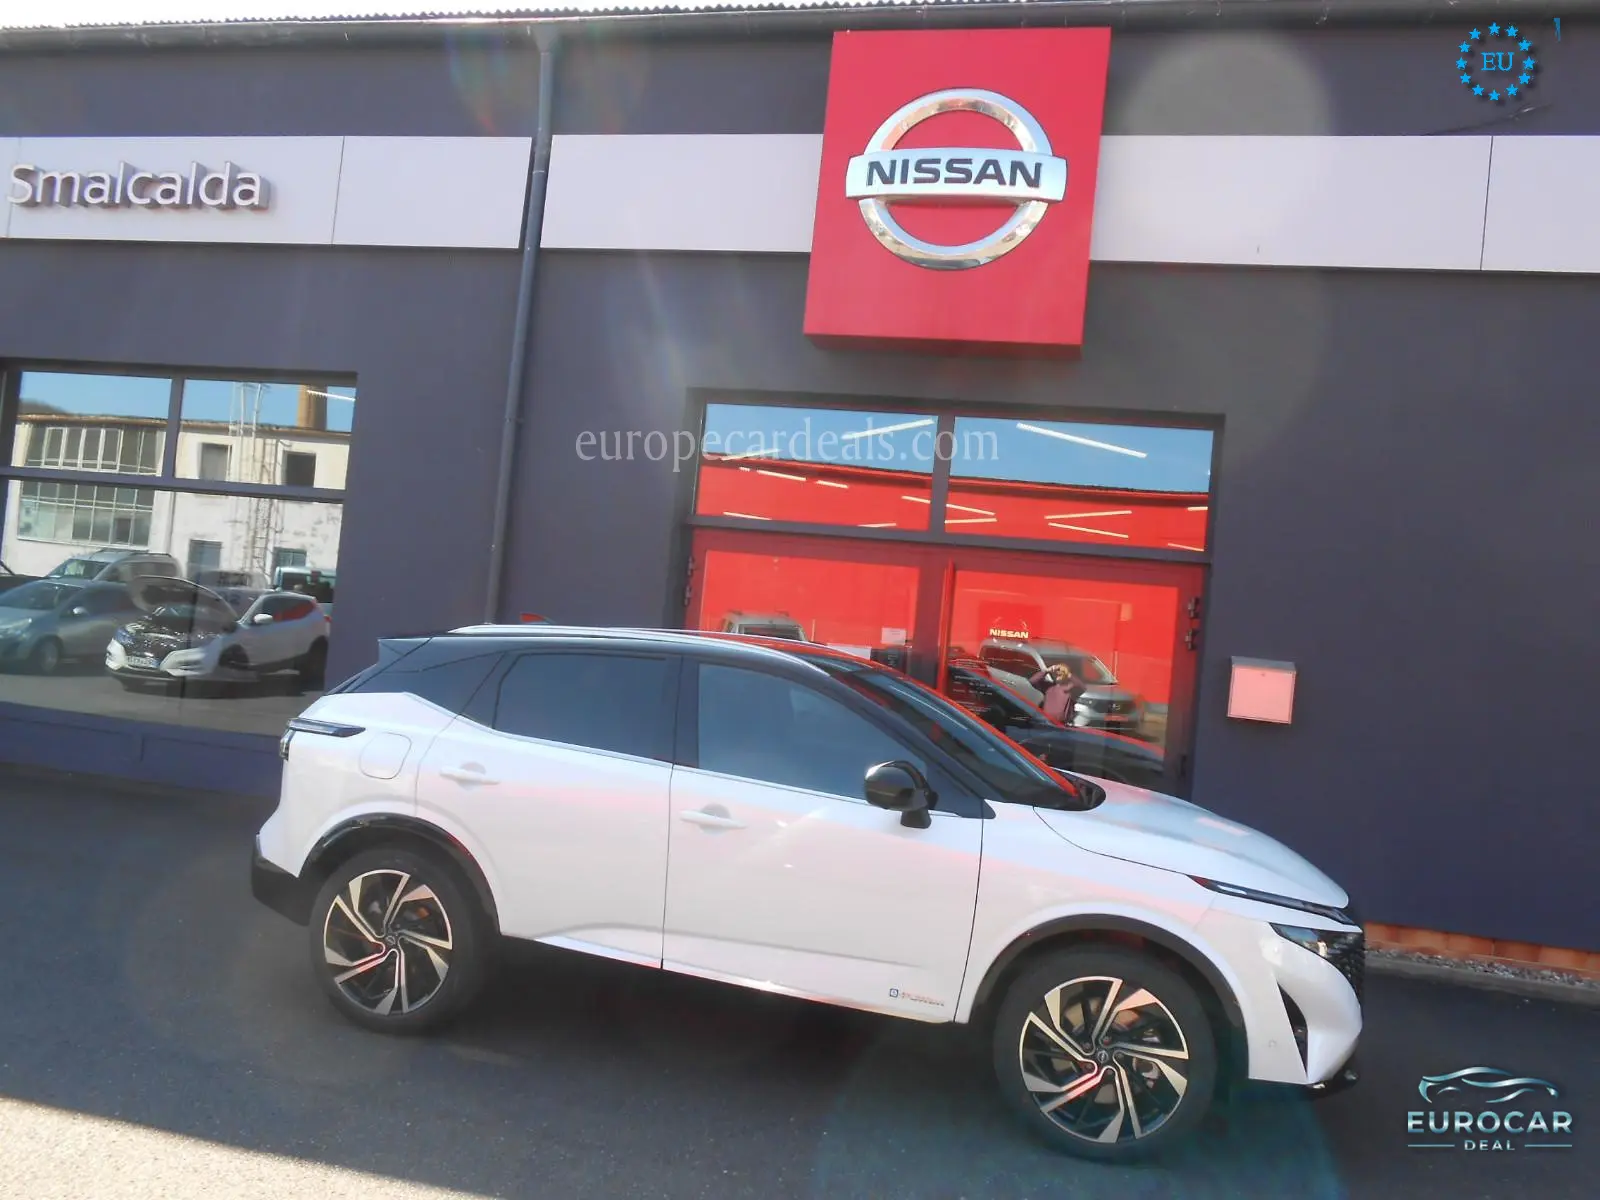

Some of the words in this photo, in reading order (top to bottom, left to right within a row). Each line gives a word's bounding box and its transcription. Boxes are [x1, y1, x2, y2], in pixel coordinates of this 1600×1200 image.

[7, 160, 268, 210] Smalcalda
[866, 158, 1043, 188] NISSAN
[989, 628, 1029, 639] NISSAN
